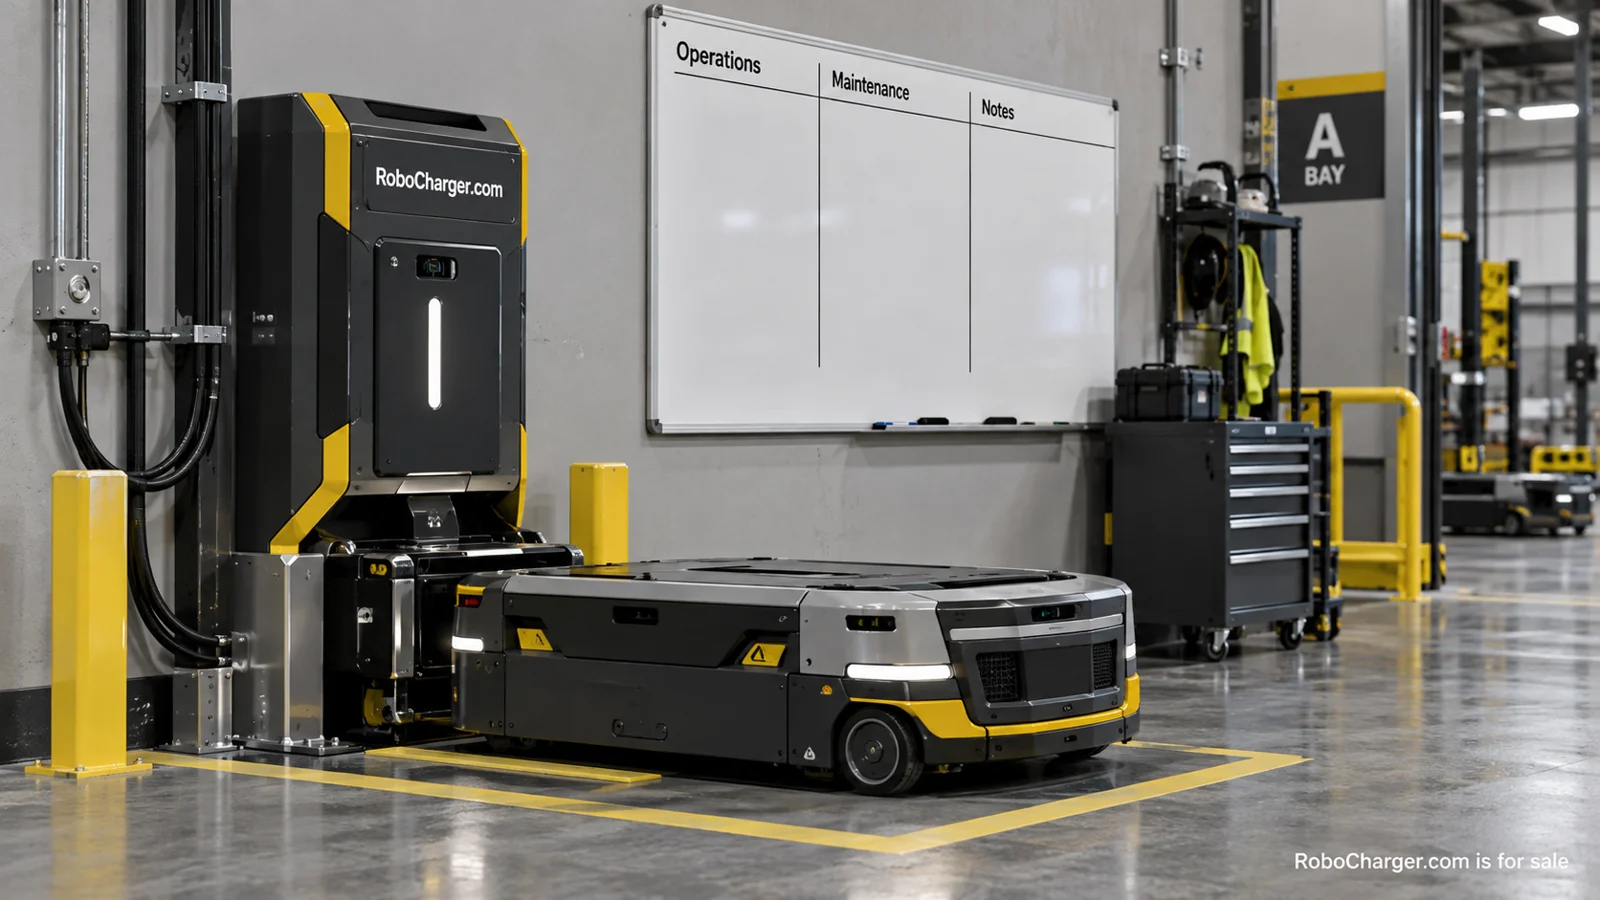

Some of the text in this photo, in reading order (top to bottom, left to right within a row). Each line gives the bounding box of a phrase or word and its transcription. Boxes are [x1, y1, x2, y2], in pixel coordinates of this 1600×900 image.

[676, 40, 761, 74] Operations
[831, 70, 910, 101] Maintenance
[981, 98, 1015, 120] Notes
[1305, 112, 1344, 161] A
[375, 166, 503, 199] RoboCharger.com
[1304, 164, 1346, 187] BAY
